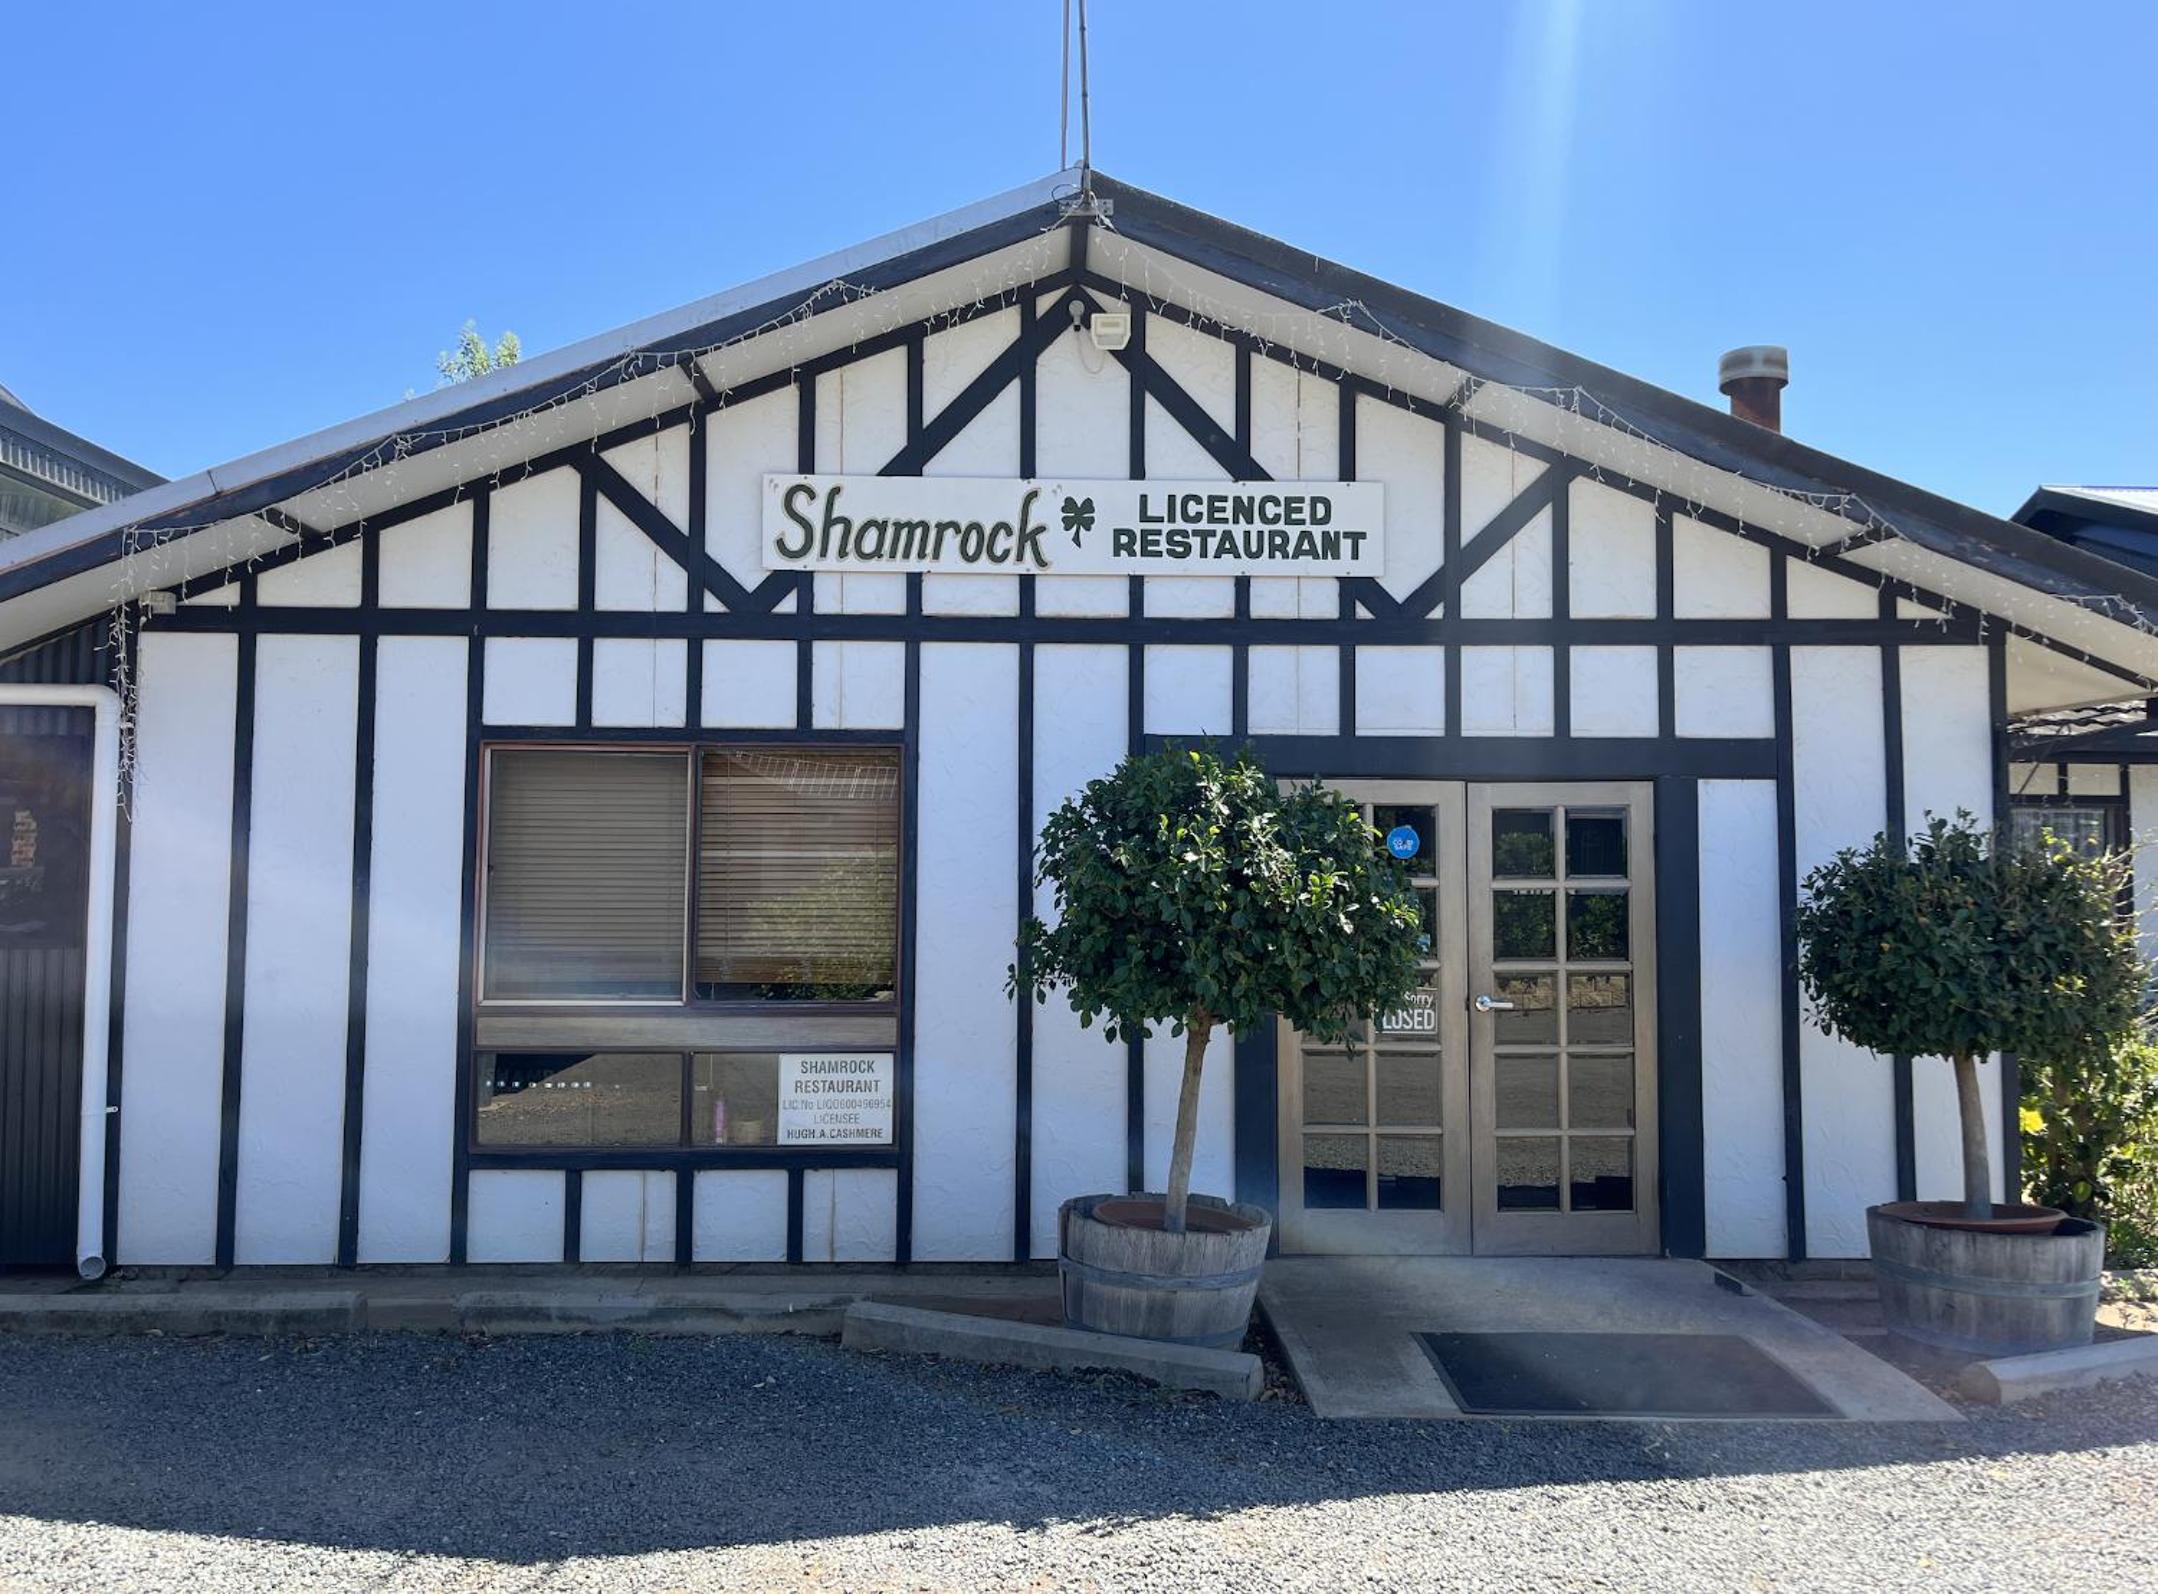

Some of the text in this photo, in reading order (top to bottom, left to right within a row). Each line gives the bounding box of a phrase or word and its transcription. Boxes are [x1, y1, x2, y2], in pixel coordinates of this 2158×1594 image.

[1139, 494, 1332, 526] LICENCED
[775, 483, 1049, 568] Shamrock
[1112, 528, 1367, 561] RESTAURANT
[1382, 1009, 1435, 1030] LOSED
[800, 1060, 875, 1074] SHAMROCK
[794, 1080, 881, 1094] RESTAURANT
[813, 1114, 860, 1125] LICENSEE
